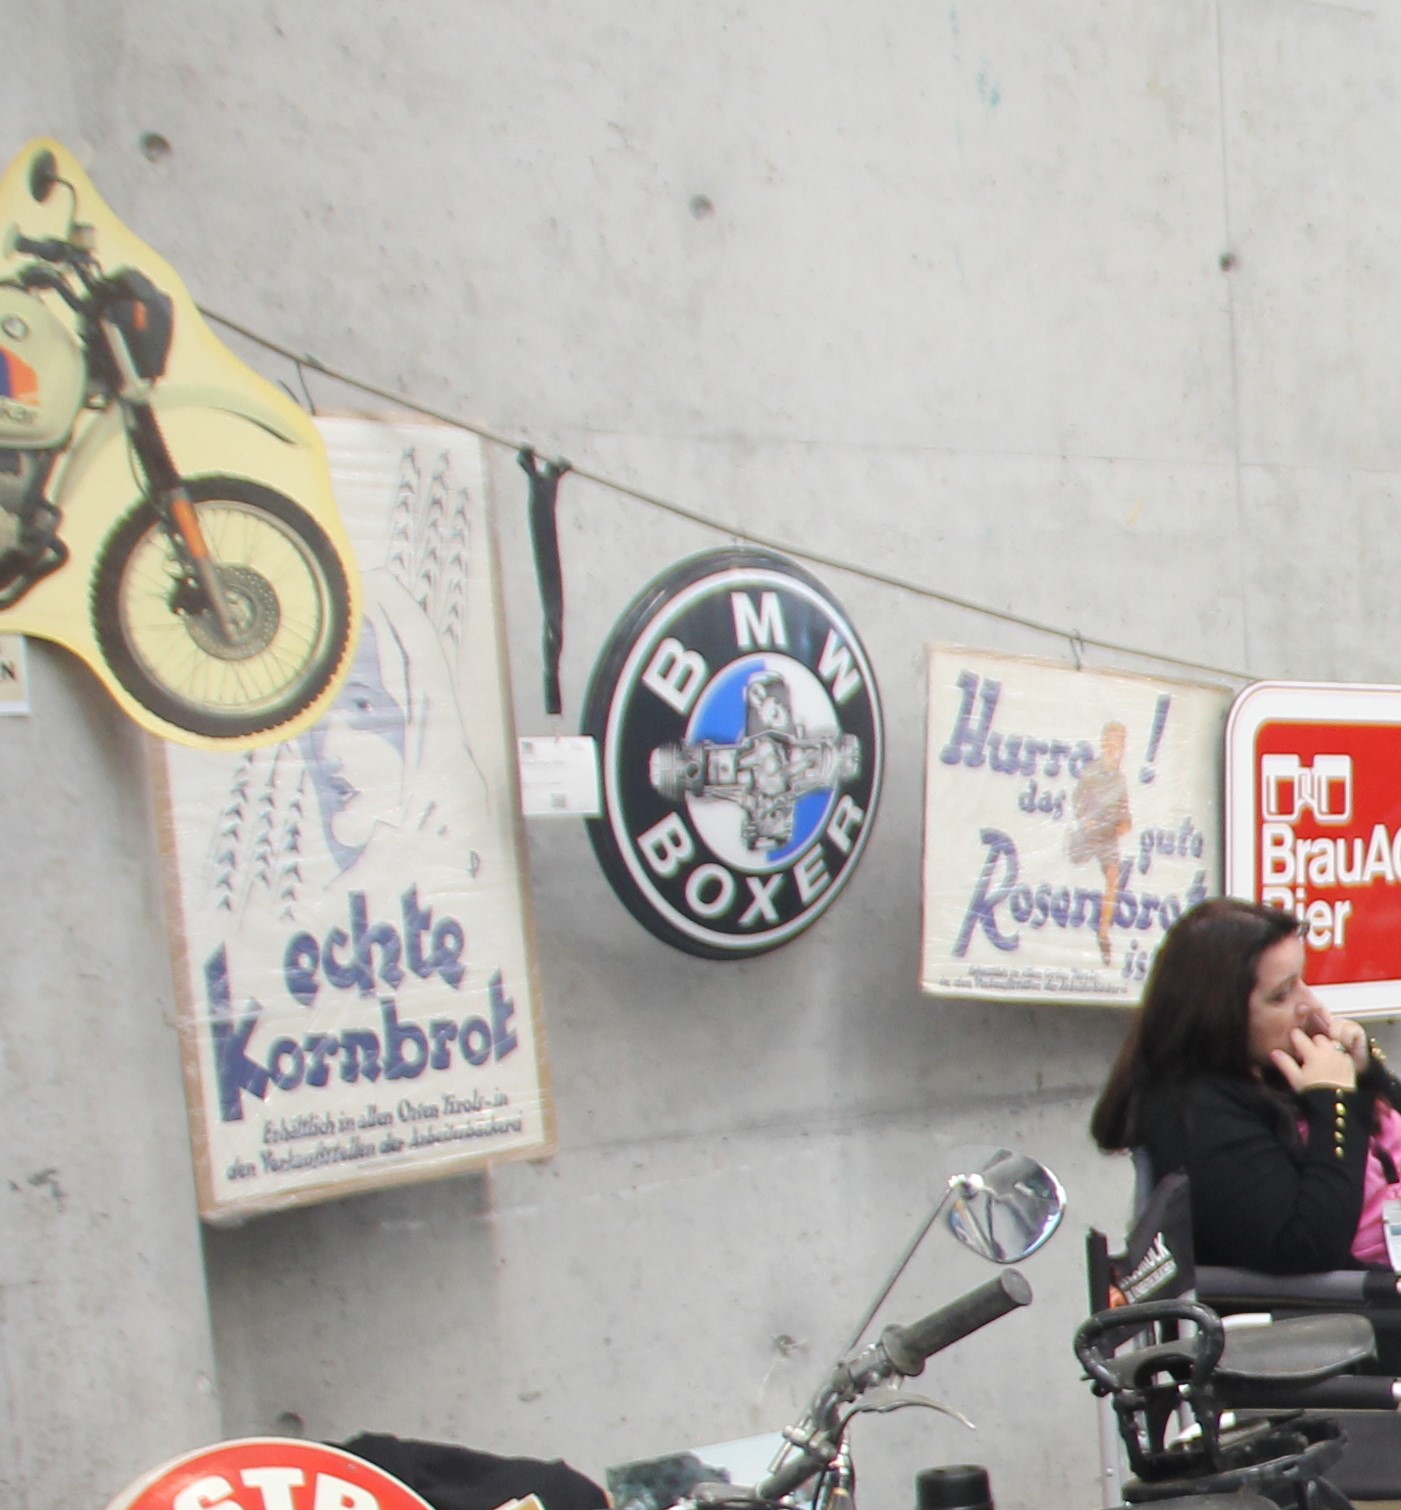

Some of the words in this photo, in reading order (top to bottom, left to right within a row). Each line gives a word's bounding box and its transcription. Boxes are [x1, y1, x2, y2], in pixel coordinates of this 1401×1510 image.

[642, 590, 864, 718] BMW
[636, 794, 866, 927] BOXER
[283, 882, 466, 1006] echte
[203, 940, 519, 1122] Kornbrot
